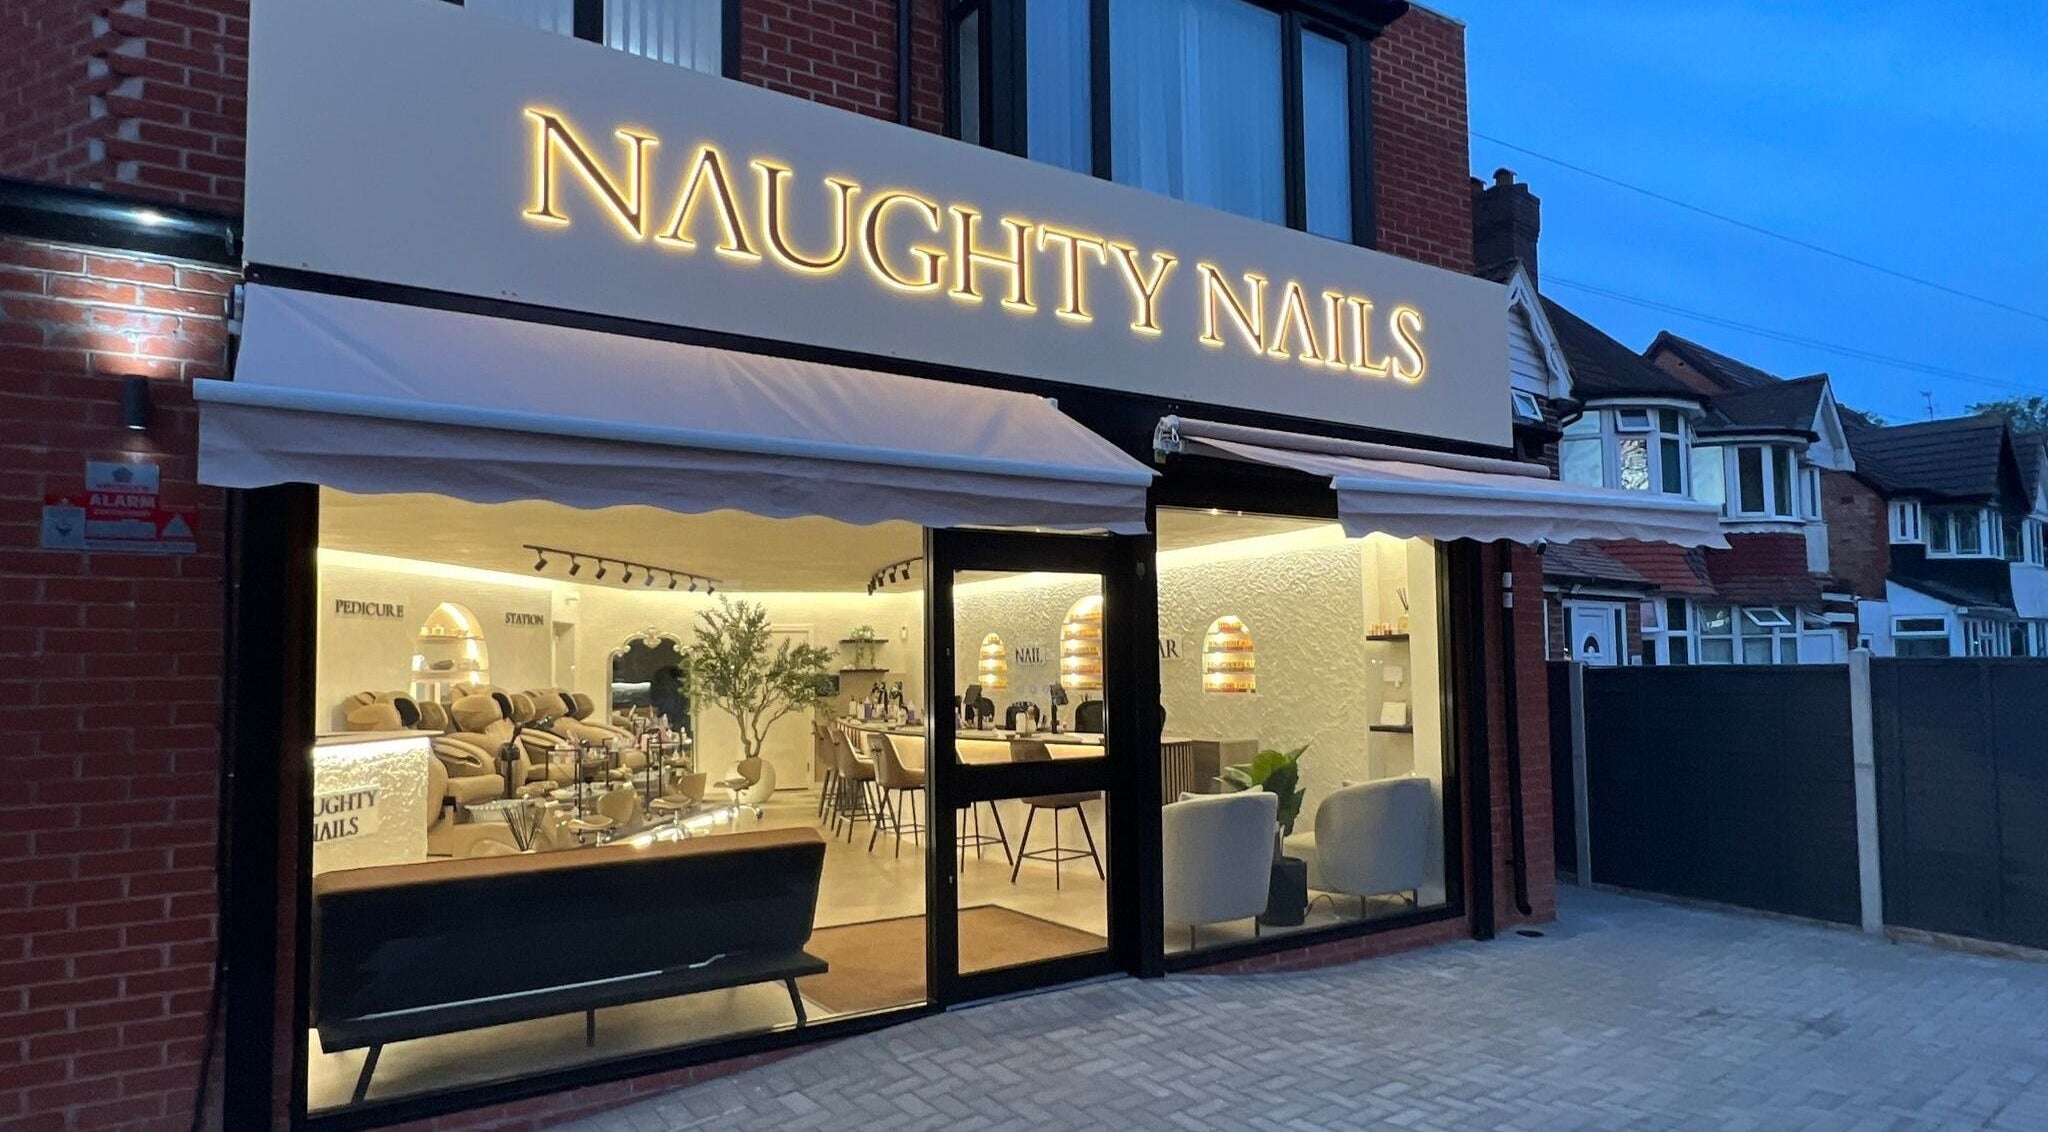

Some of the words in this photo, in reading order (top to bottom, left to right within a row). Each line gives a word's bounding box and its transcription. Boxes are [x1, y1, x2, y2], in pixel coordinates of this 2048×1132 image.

[523, 107, 1178, 334] NAUGHTY
[1197, 262, 1426, 382] NAILS
[90, 493, 155, 508] ALARM
[335, 599, 404, 618] PEDICURE
[505, 612, 544, 625] STATION
